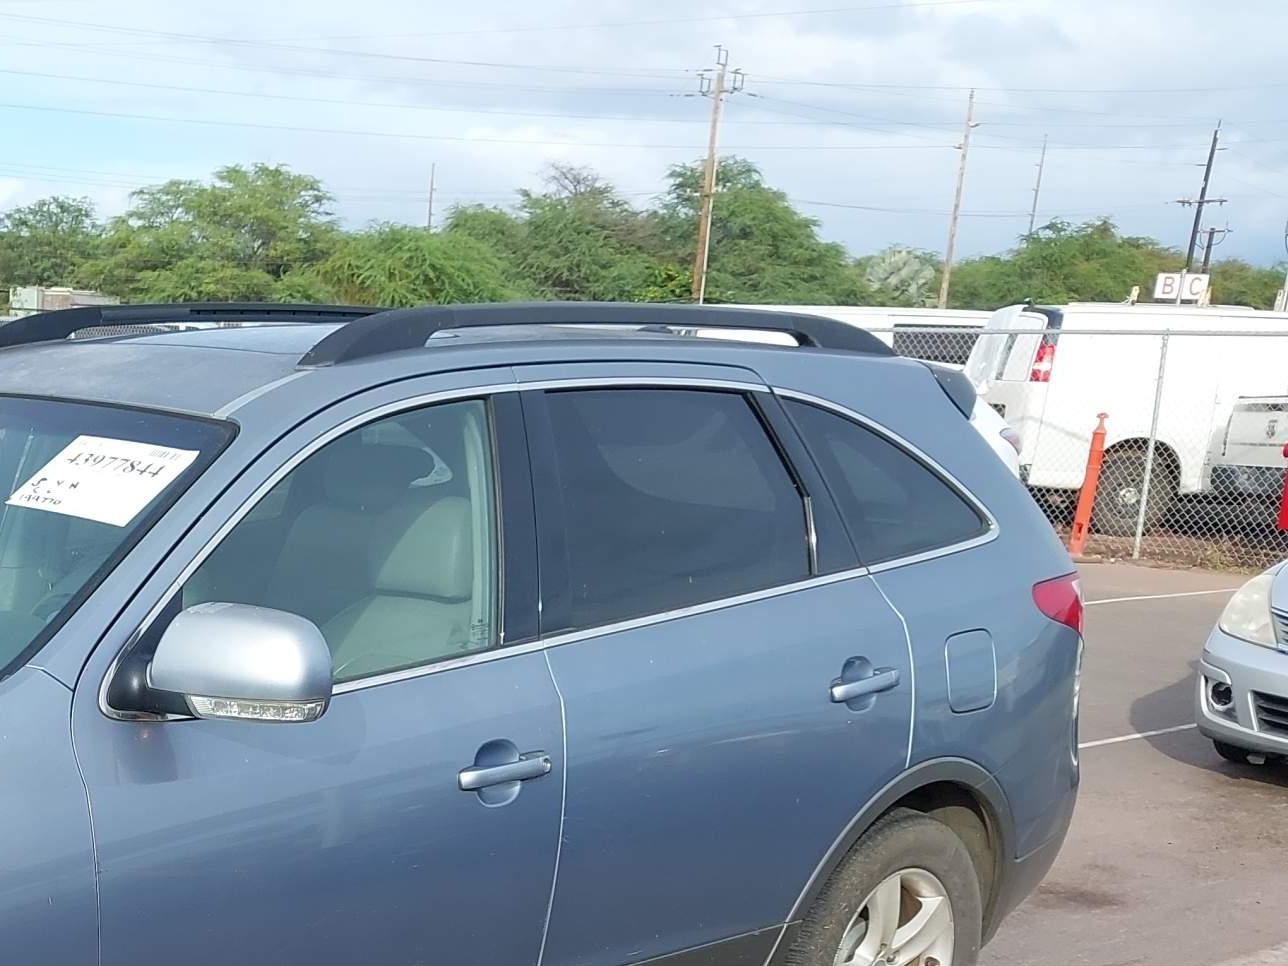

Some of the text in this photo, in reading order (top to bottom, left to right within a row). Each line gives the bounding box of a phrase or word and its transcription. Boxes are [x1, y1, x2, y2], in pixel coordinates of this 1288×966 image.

[1162, 276, 1202, 295] B C
[67, 452, 165, 478] 43977844
